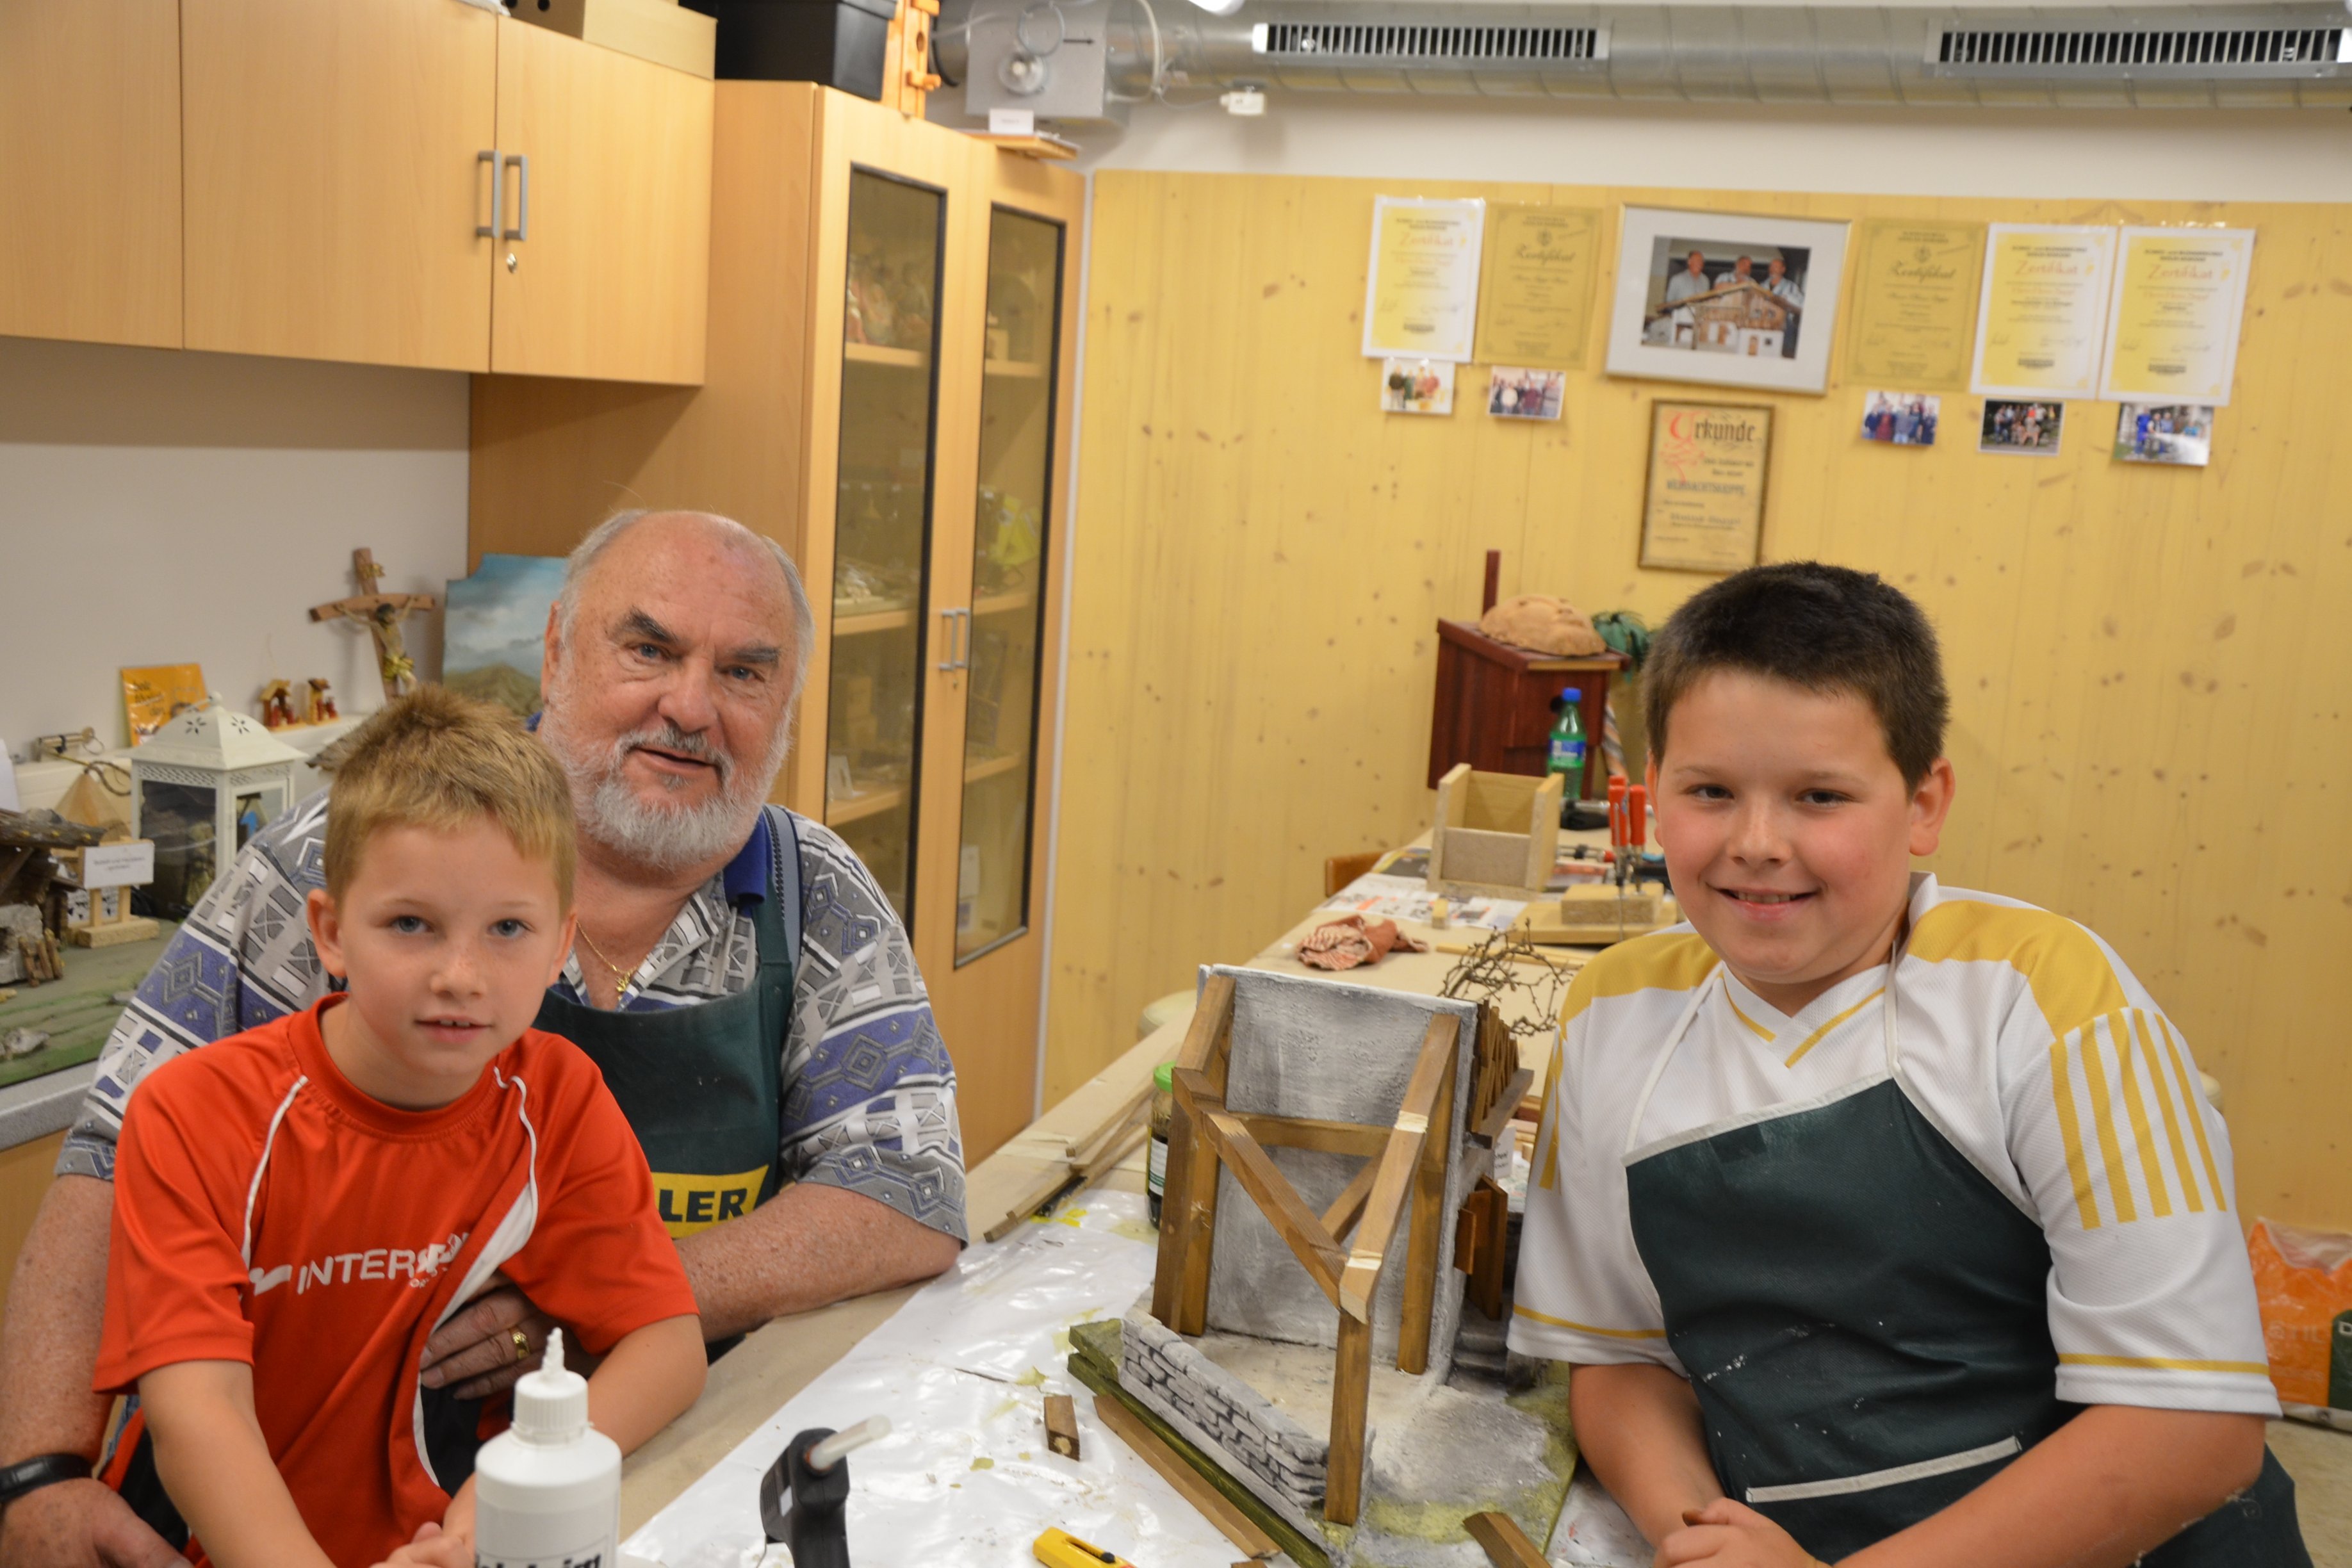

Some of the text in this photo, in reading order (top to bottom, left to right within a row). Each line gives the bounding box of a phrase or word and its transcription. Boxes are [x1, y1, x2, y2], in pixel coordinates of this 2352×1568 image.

[1398, 231, 1454, 248] Zertifikat
[2014, 259, 2078, 276] Zertifikat
[2148, 263, 2213, 280] Zertifikat
[1667, 411, 1756, 444] Urkunde
